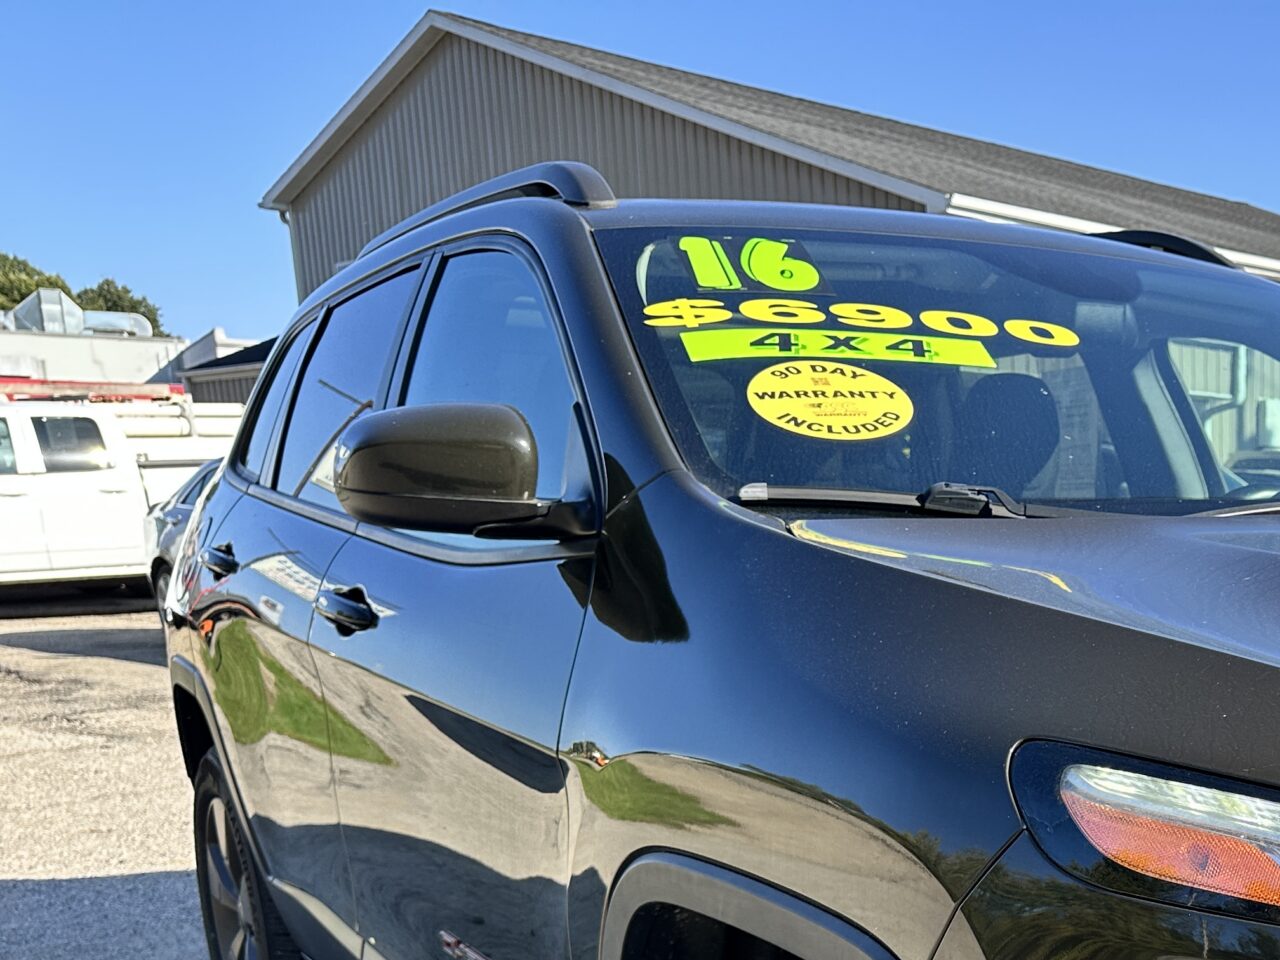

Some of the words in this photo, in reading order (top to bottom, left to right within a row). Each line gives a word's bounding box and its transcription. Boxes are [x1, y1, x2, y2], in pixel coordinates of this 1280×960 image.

[679, 236, 820, 291] 16
[640, 298, 1080, 346] $6900
[769, 366, 802, 379] 90
[810, 364, 867, 379] DAY
[754, 390, 897, 399] WARRANTY
[776, 411, 900, 434] INCLUDED
